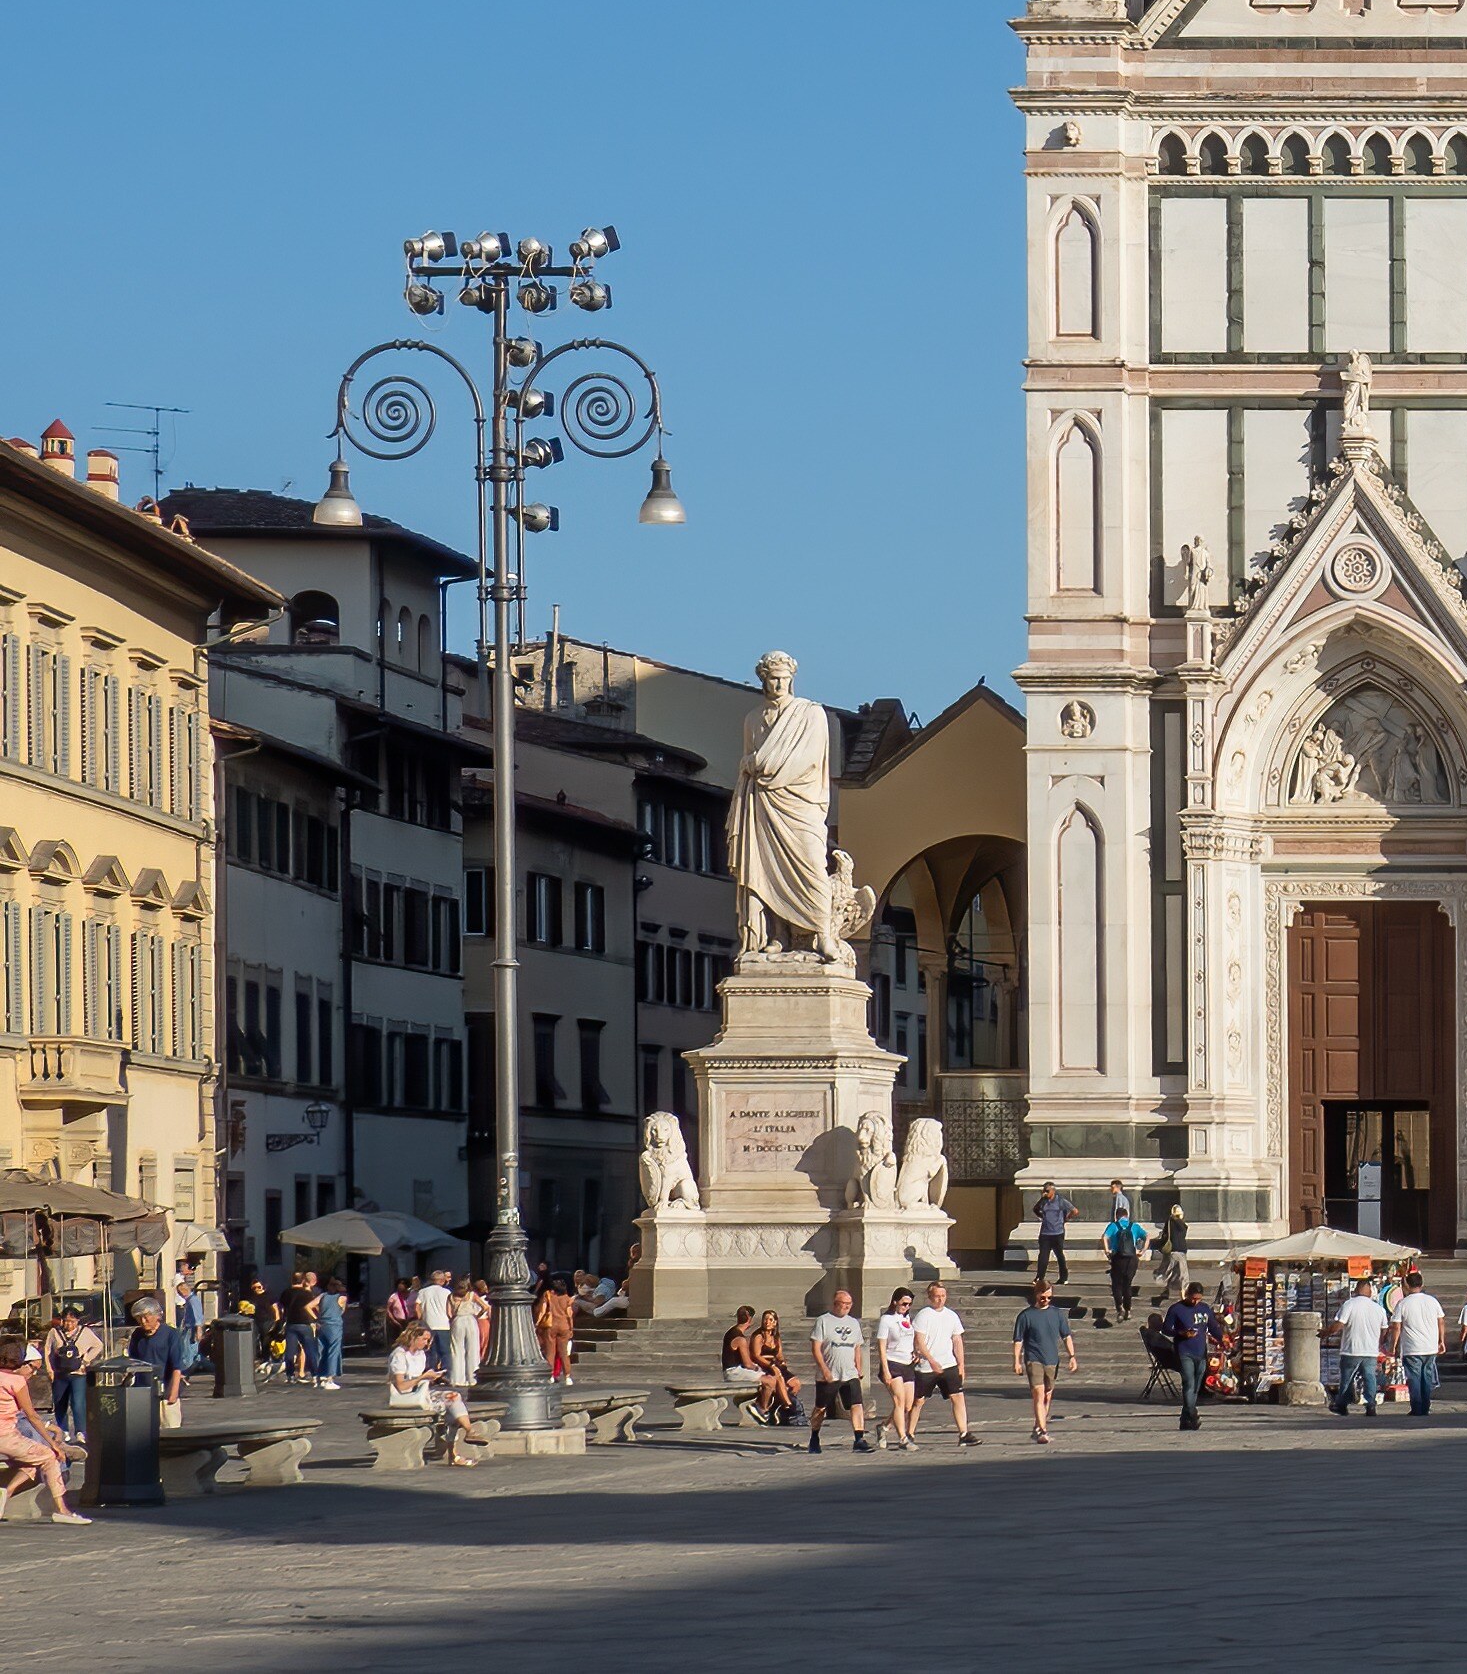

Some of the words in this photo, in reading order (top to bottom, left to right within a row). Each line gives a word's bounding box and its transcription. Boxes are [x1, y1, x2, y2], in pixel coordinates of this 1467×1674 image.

[729, 1110, 736, 1118] A
[740, 1110, 770, 1118] DANTE
[773, 1110, 820, 1118] ALIGHIERI
